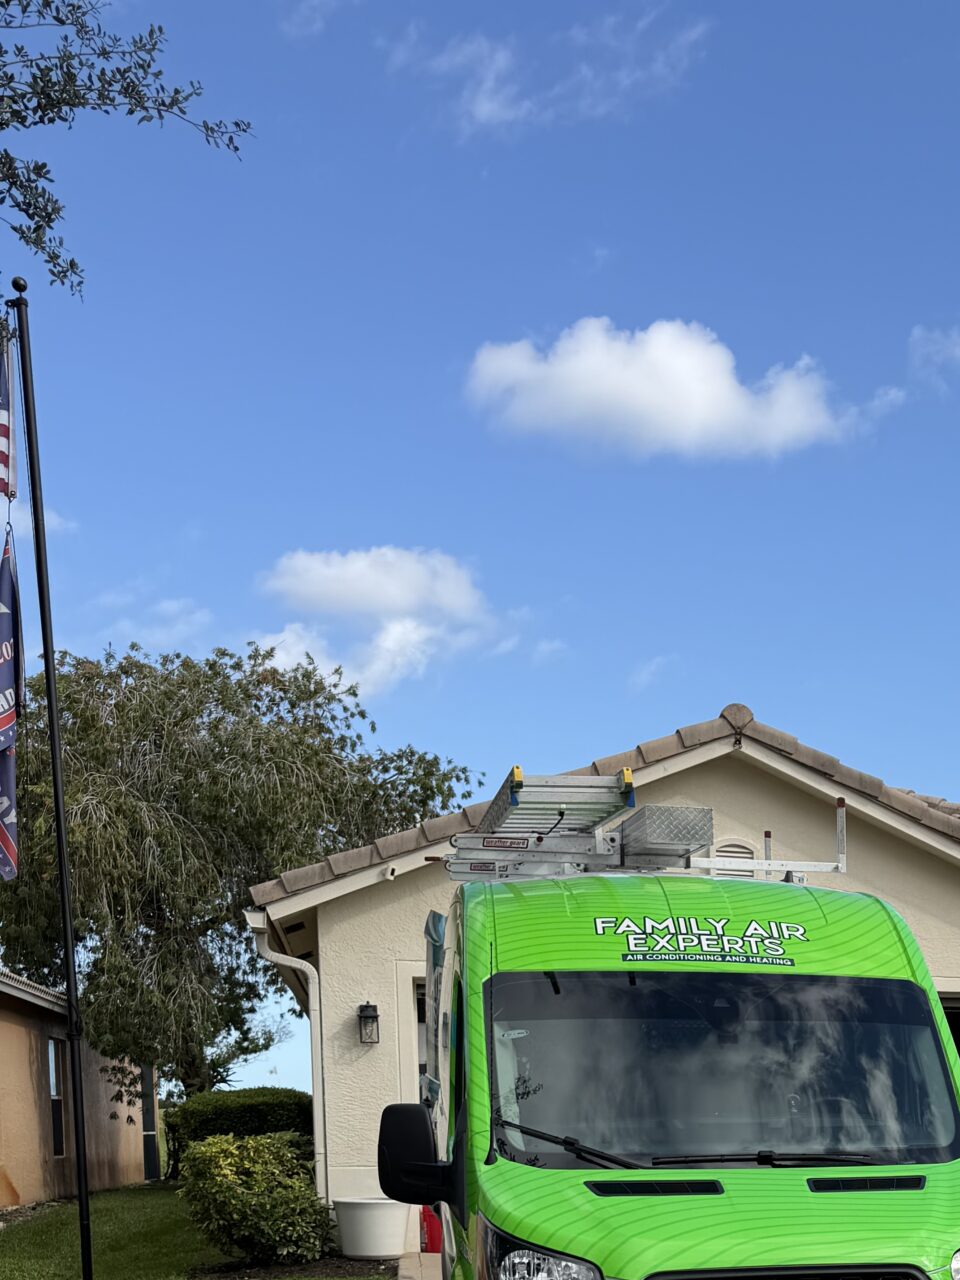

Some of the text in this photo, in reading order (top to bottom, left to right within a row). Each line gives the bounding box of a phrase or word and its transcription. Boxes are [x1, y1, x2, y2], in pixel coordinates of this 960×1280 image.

[594, 916, 809, 941] FAMILY AIR
[626, 934, 787, 957] EXPERTS
[646, 954, 723, 963] CONDITIONING
[749, 957, 792, 966] HEATING
